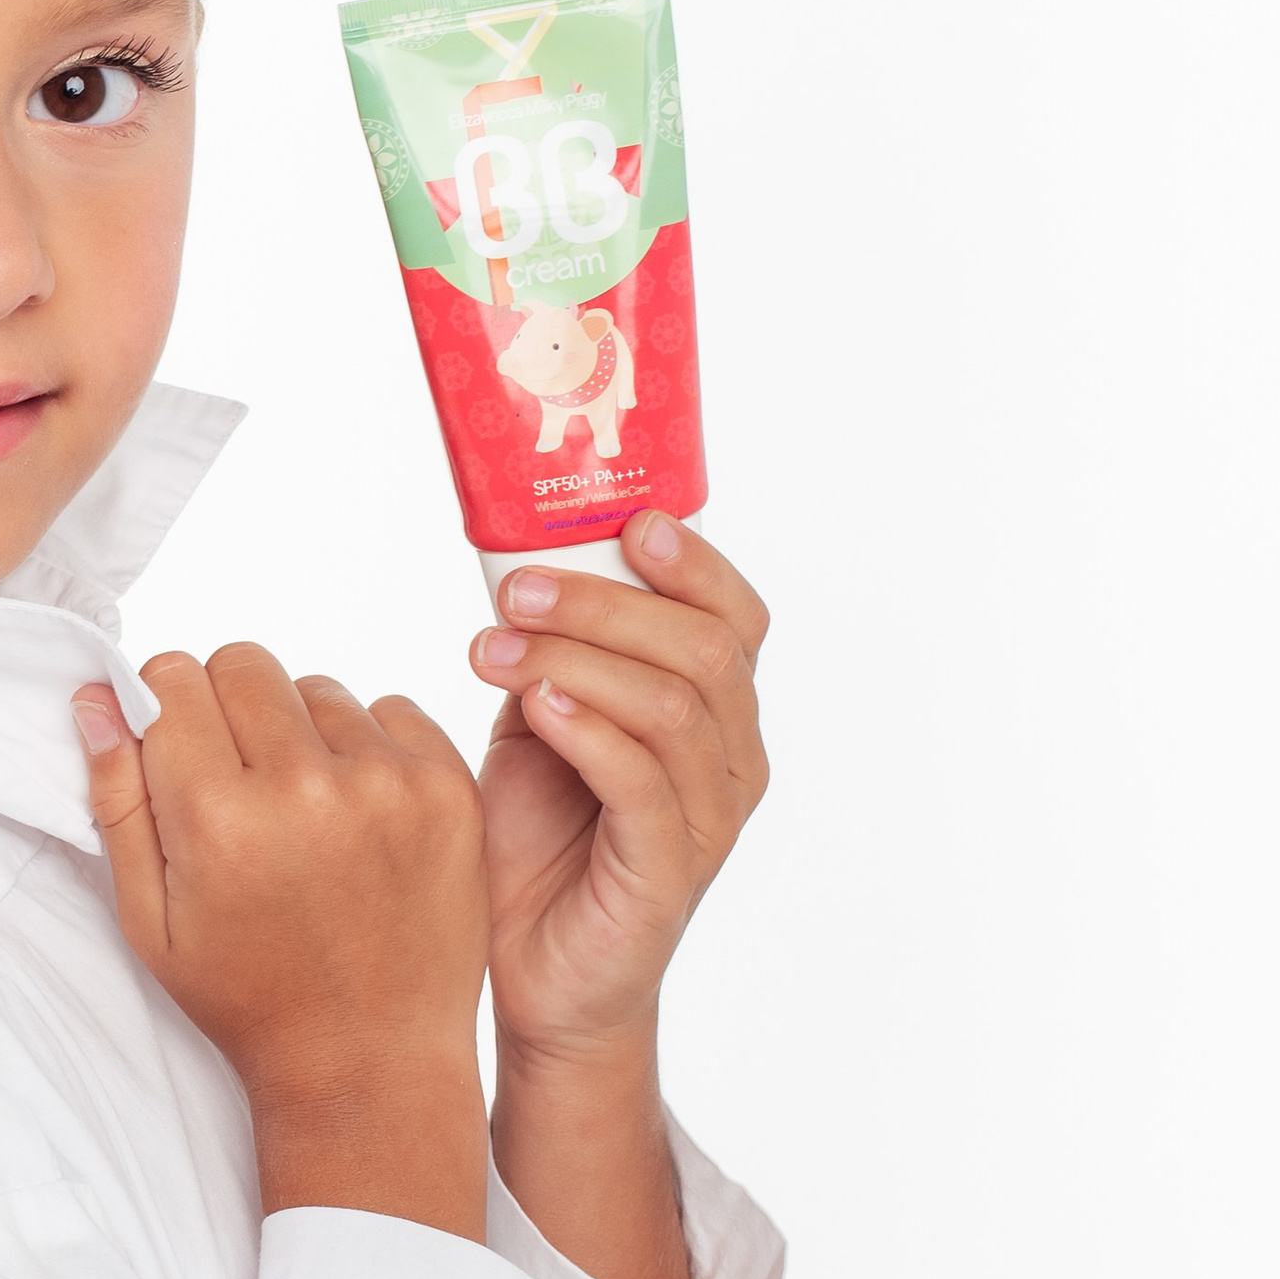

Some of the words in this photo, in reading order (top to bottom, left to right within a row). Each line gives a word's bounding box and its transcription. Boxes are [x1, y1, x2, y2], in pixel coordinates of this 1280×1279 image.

[566, 91, 606, 112] Piggy
[454, 119, 629, 259] BB
[506, 251, 607, 289] cream
[533, 474, 590, 496] SPF50+
[593, 467, 646, 486] PA+++
